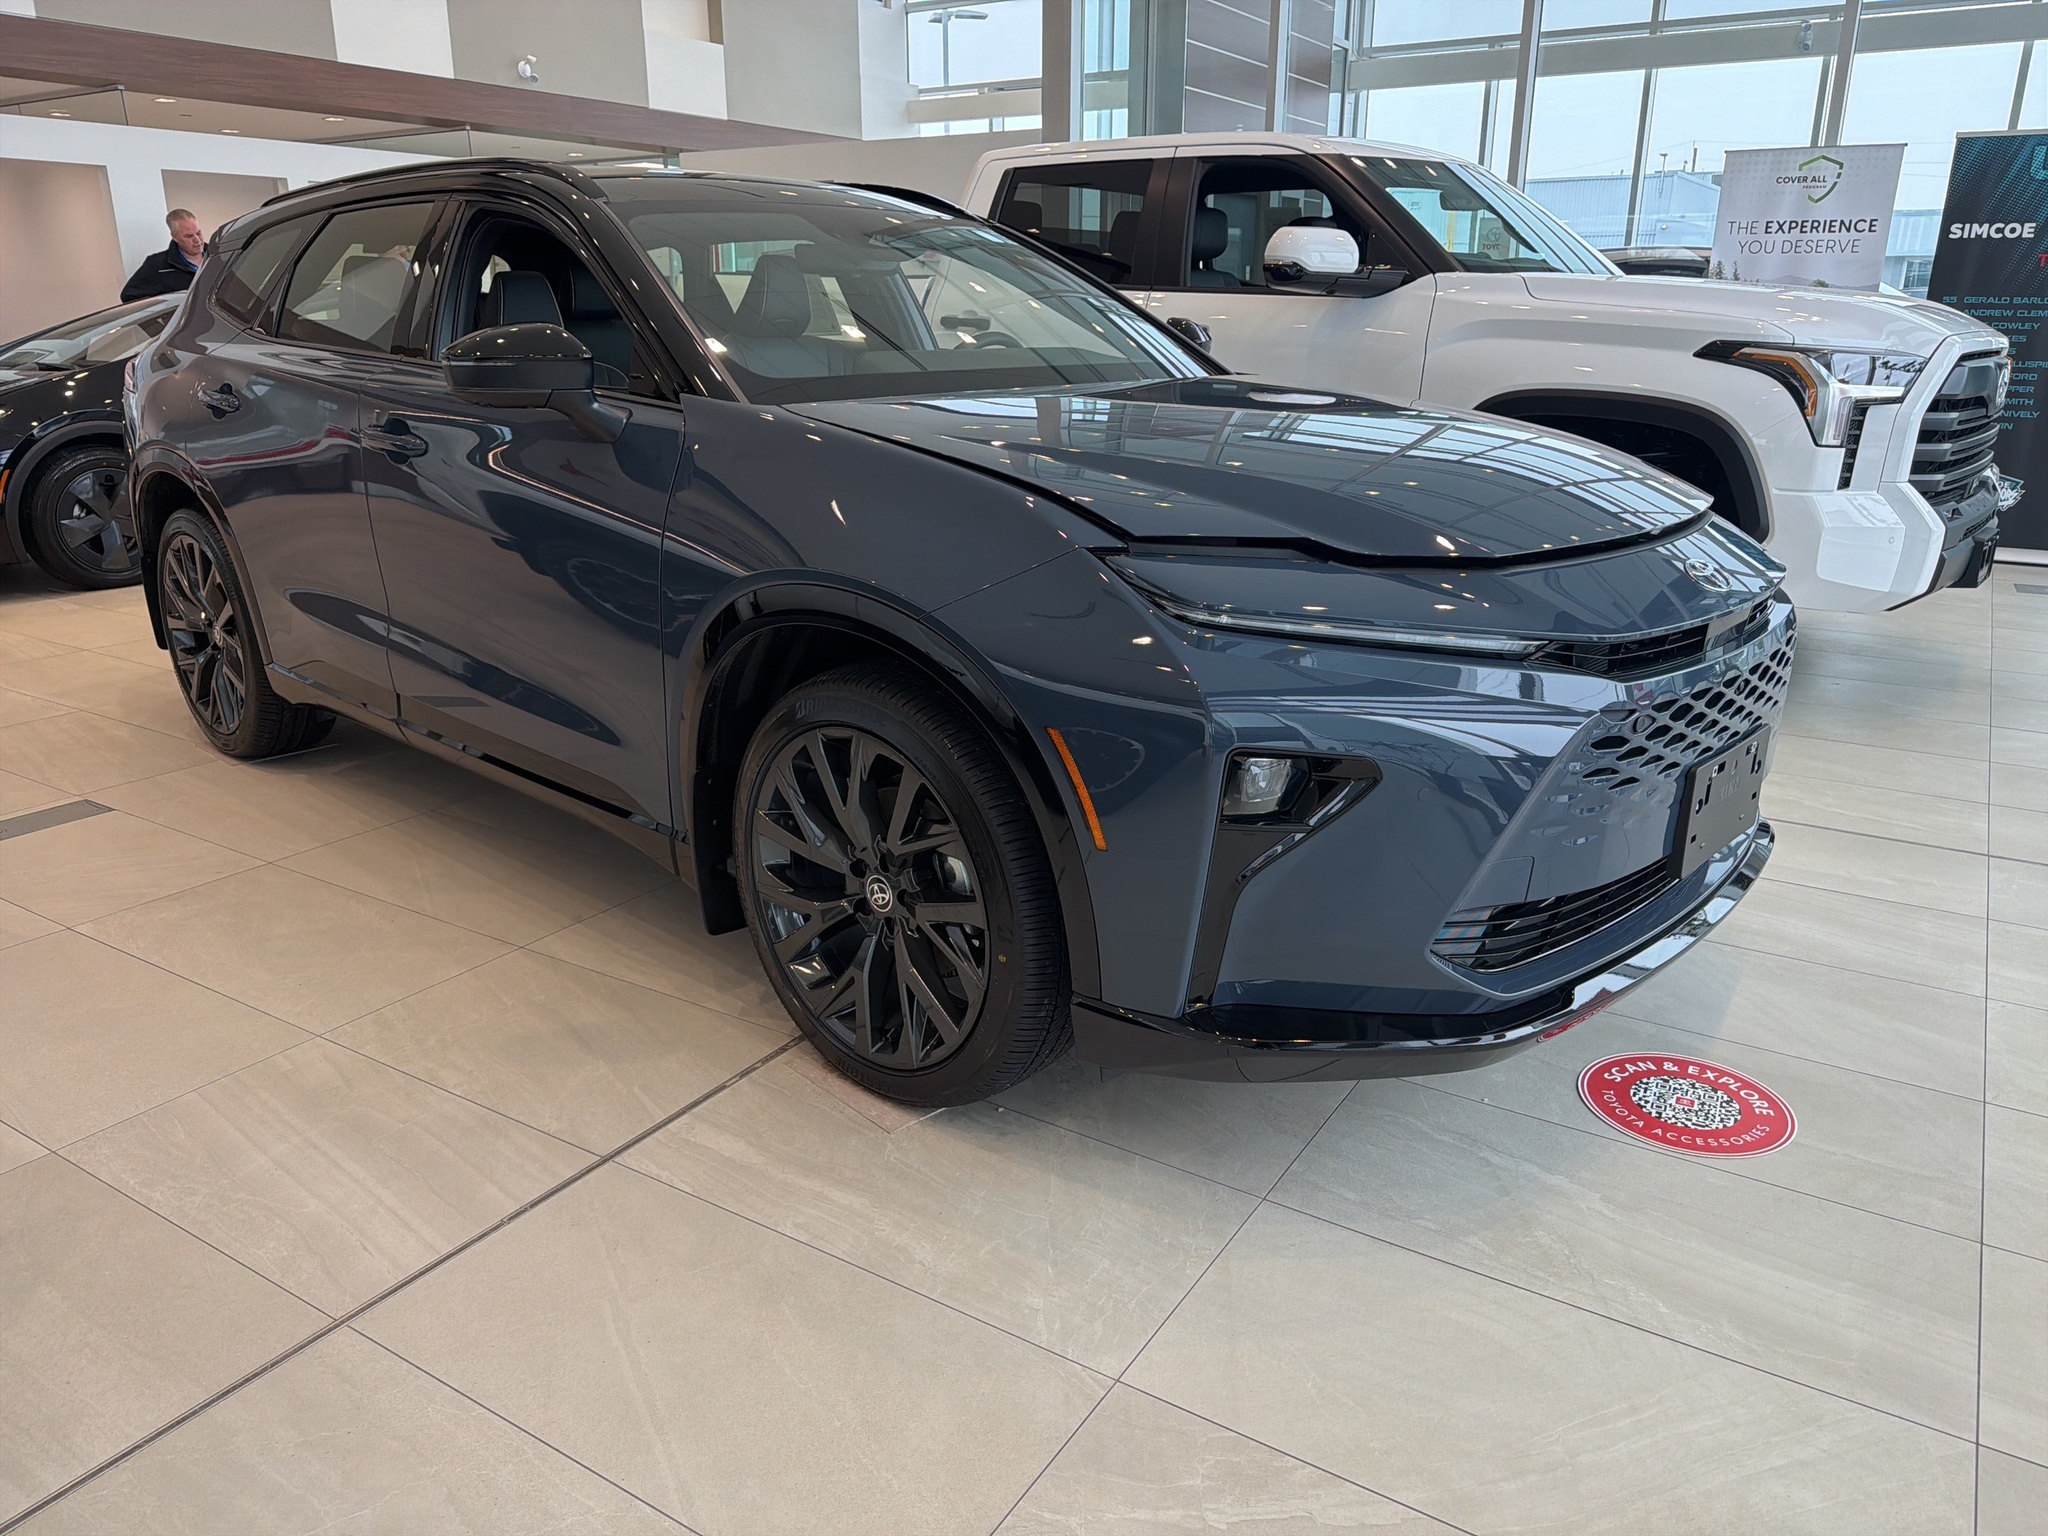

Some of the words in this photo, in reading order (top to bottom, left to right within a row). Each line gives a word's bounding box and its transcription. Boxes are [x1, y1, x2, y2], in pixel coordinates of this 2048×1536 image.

[1775, 175, 1808, 185] COVER
[1809, 174, 1828, 183] ALL
[1727, 220, 1759, 235] THE
[1764, 218, 1879, 235] EXPERIENCE
[1948, 222, 2037, 239] SIMCOE
[1738, 239, 1776, 254] YOU
[1780, 238, 1861, 254] DESERVE
[1963, 296, 2010, 304] GERALD
[1963, 309, 2014, 317] ANDREW
[1991, 322, 2041, 330] COWLEY
[1603, 1060, 1657, 1083] SCAN
[1662, 1061, 1681, 1072] &
[1687, 1065, 1775, 1117] EXPLORE
[1601, 1089, 1644, 1128] TOYOTA
[1651, 1123, 1771, 1147] ACCESSORIES
